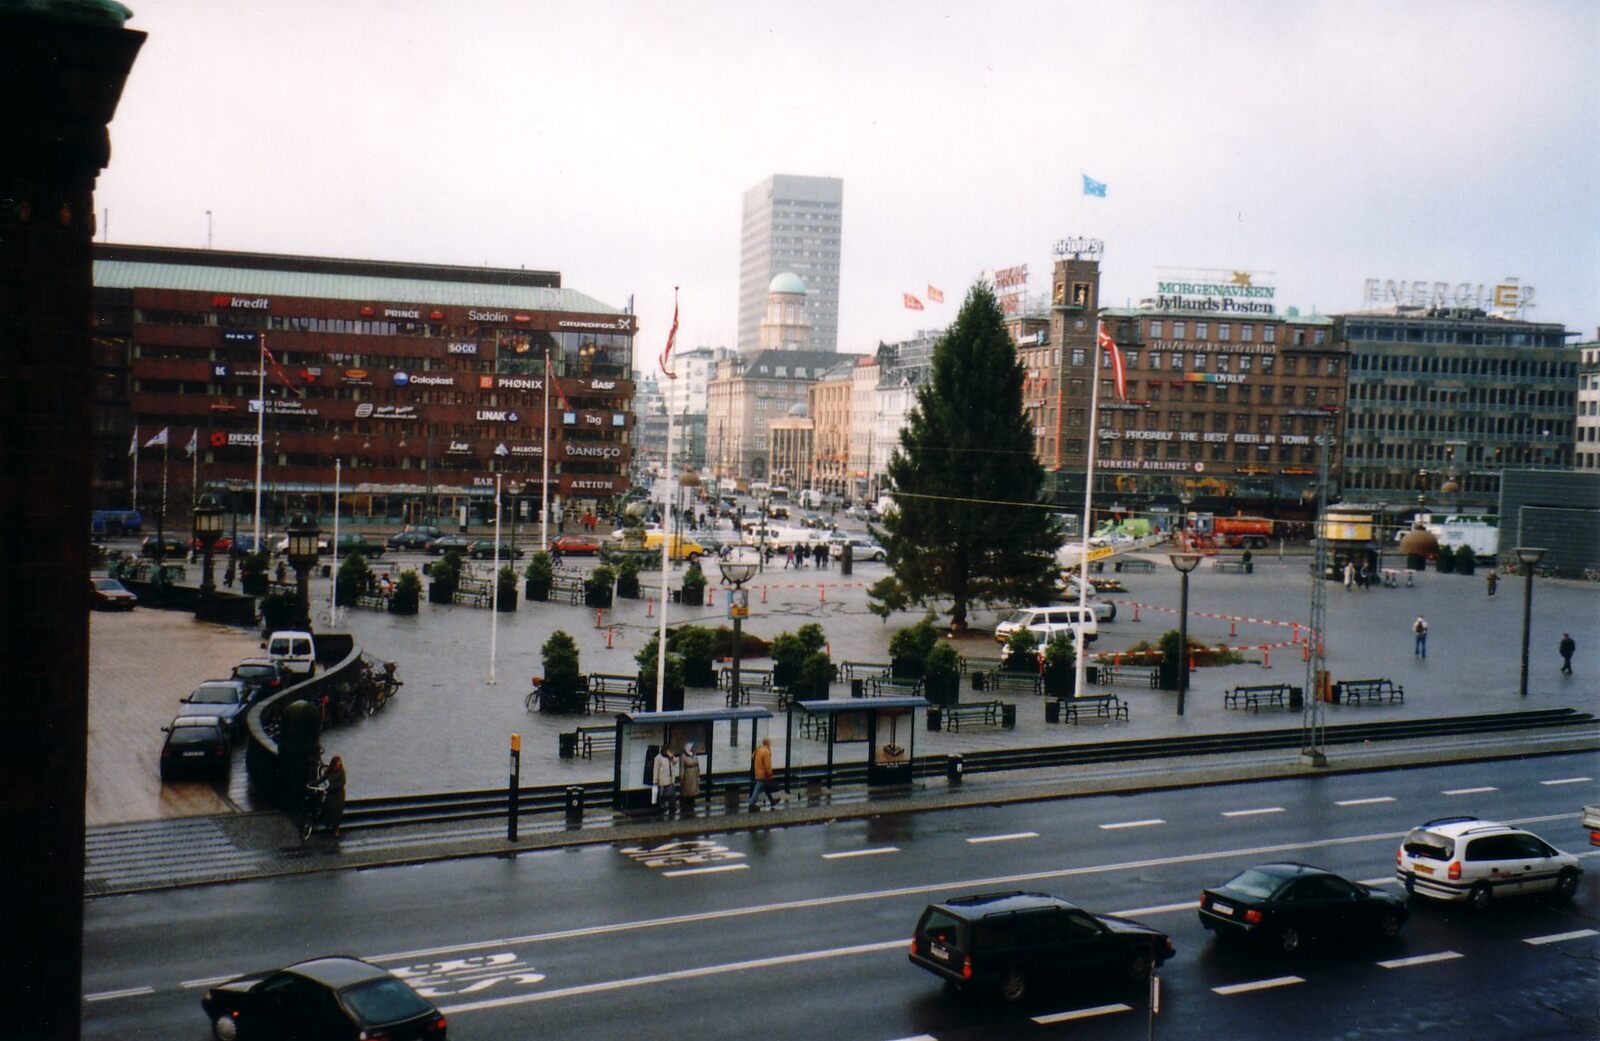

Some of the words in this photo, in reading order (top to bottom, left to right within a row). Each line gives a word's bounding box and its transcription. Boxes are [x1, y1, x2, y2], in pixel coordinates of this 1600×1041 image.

[1158, 282, 1275, 298] MORGENAVISEN
[231, 297, 269, 309] kredit
[1156, 295, 1220, 311] Jyllands
[1223, 298, 1273, 313] Posten
[385, 309, 420, 319] PRINCE
[468, 310, 508, 322] Sadolin
[558, 320, 617, 329] GRUNDFOS
[410, 375, 454, 386] Coloplast
[498, 379, 543, 390] PHØNIX
[477, 410, 506, 421] LINAK
[585, 414, 602, 425] Tag
[1126, 430, 1173, 440] PROBABLY
[1179, 432, 1198, 441] THE
[1204, 432, 1228, 442] BEST
[1281, 435, 1309, 444] TOWN
[566, 446, 621, 457] DANISCO
[1098, 460, 1139, 469] TURKISH
[1142, 461, 1187, 471] AIRLINES
[474, 478, 493, 486] BAR
[571, 481, 613, 489] ARTIUM
